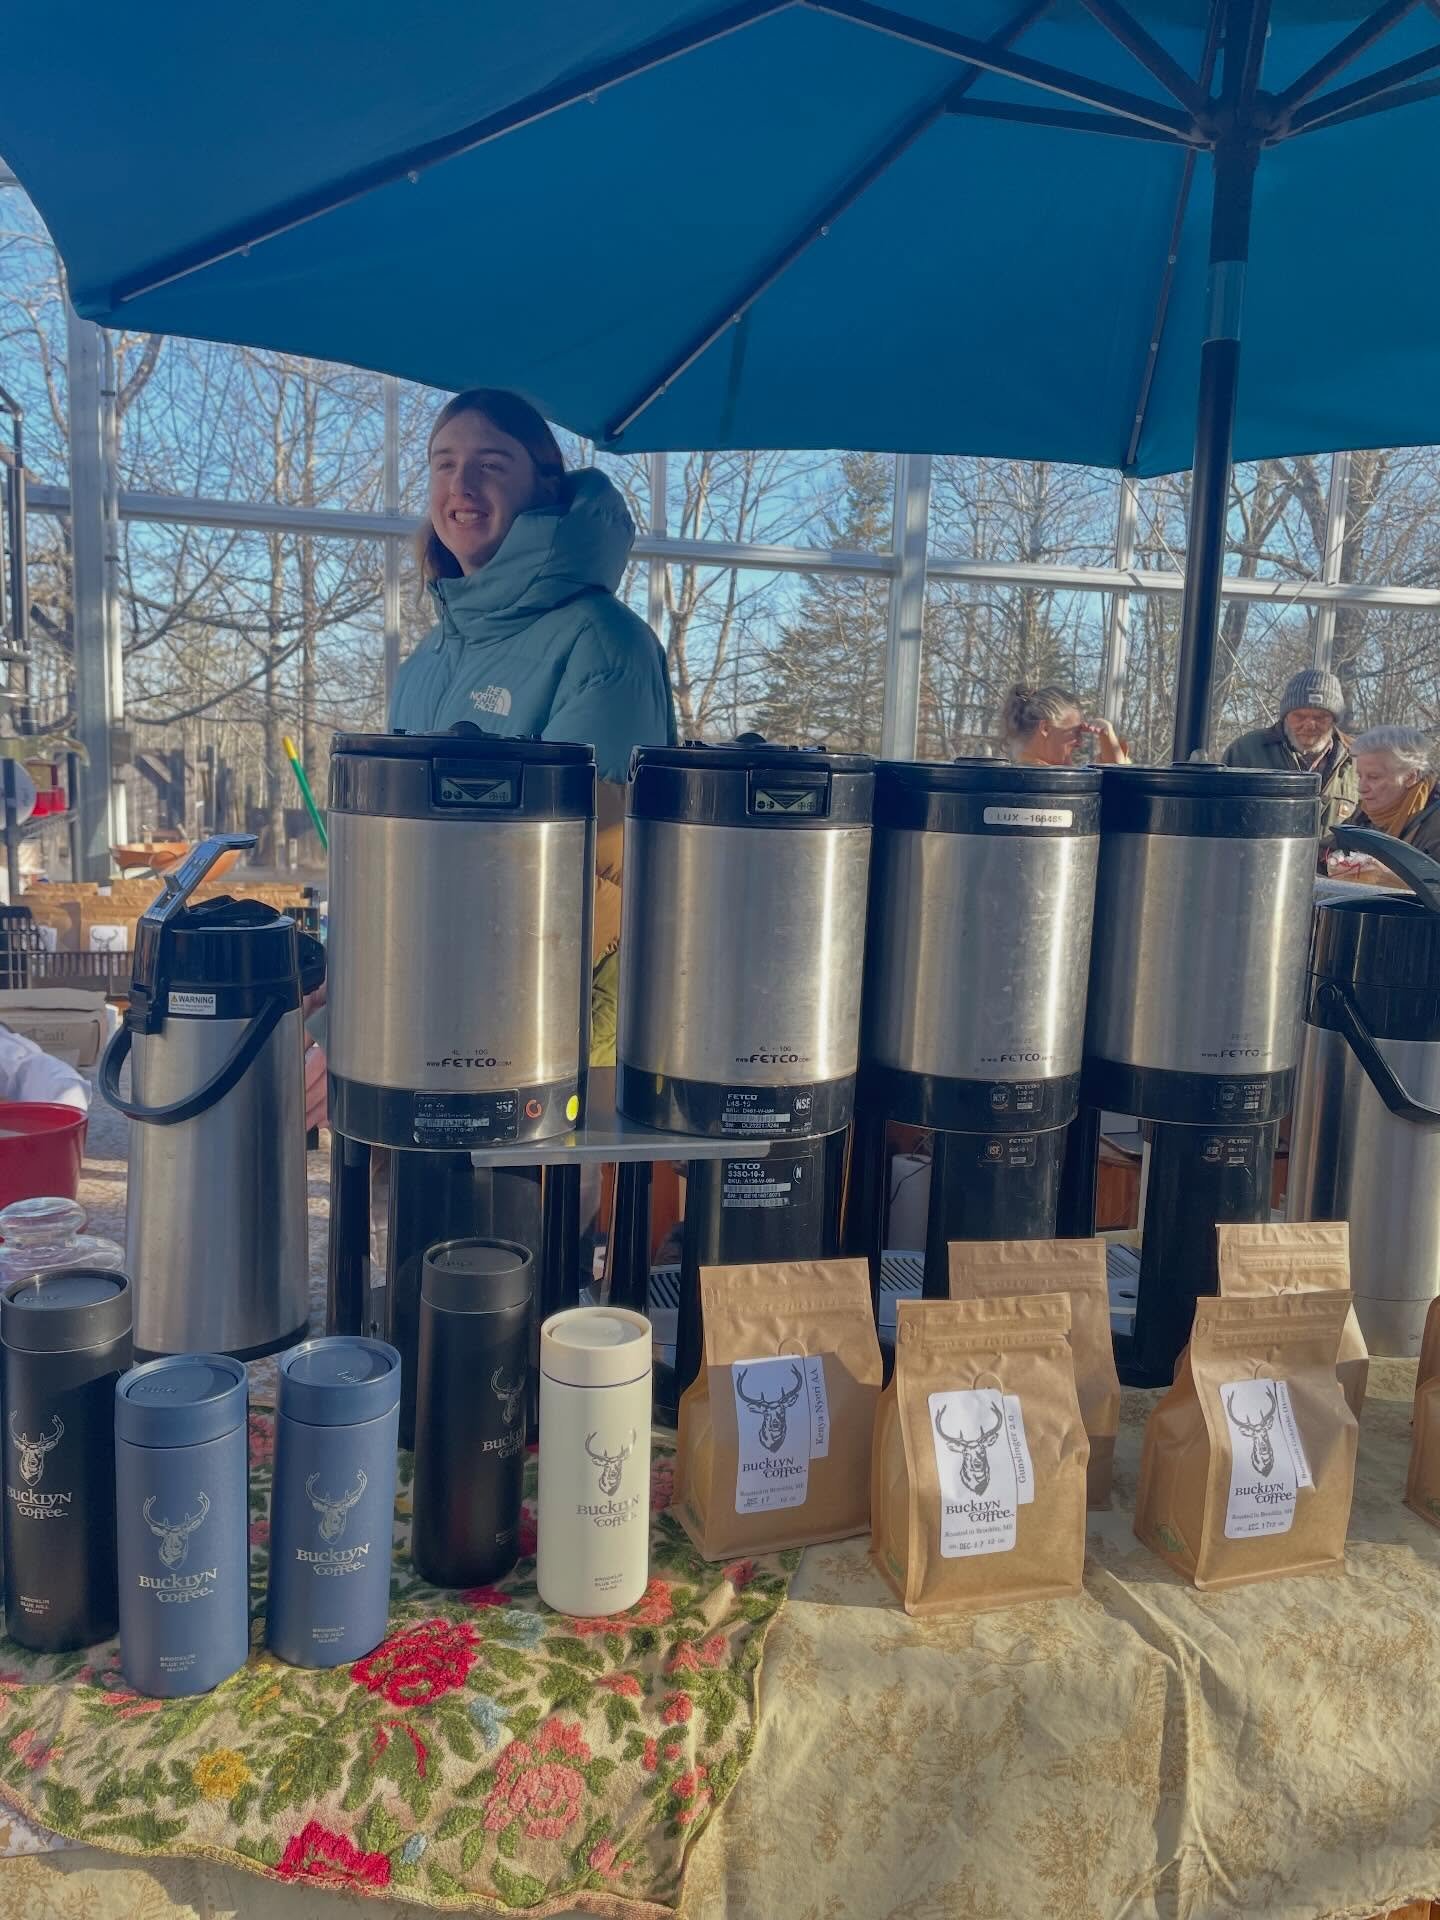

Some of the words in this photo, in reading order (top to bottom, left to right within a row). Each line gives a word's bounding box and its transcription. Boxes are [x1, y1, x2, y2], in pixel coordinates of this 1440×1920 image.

[487, 685, 502, 694] THE
[470, 690, 499, 705] NORTH
[474, 702, 497, 713] FACE
[996, 813, 1019, 821] LUX
[178, 995, 214, 1004] WARNING
[796, 1098, 811, 1110] NSF
[809, 1368, 819, 1383] AA
[814, 1386, 825, 1413] Nyeri
[815, 1416, 826, 1445] Kenya
[1011, 1433, 1026, 1484] Gunslinger
[960, 1542, 971, 1550] DEC
